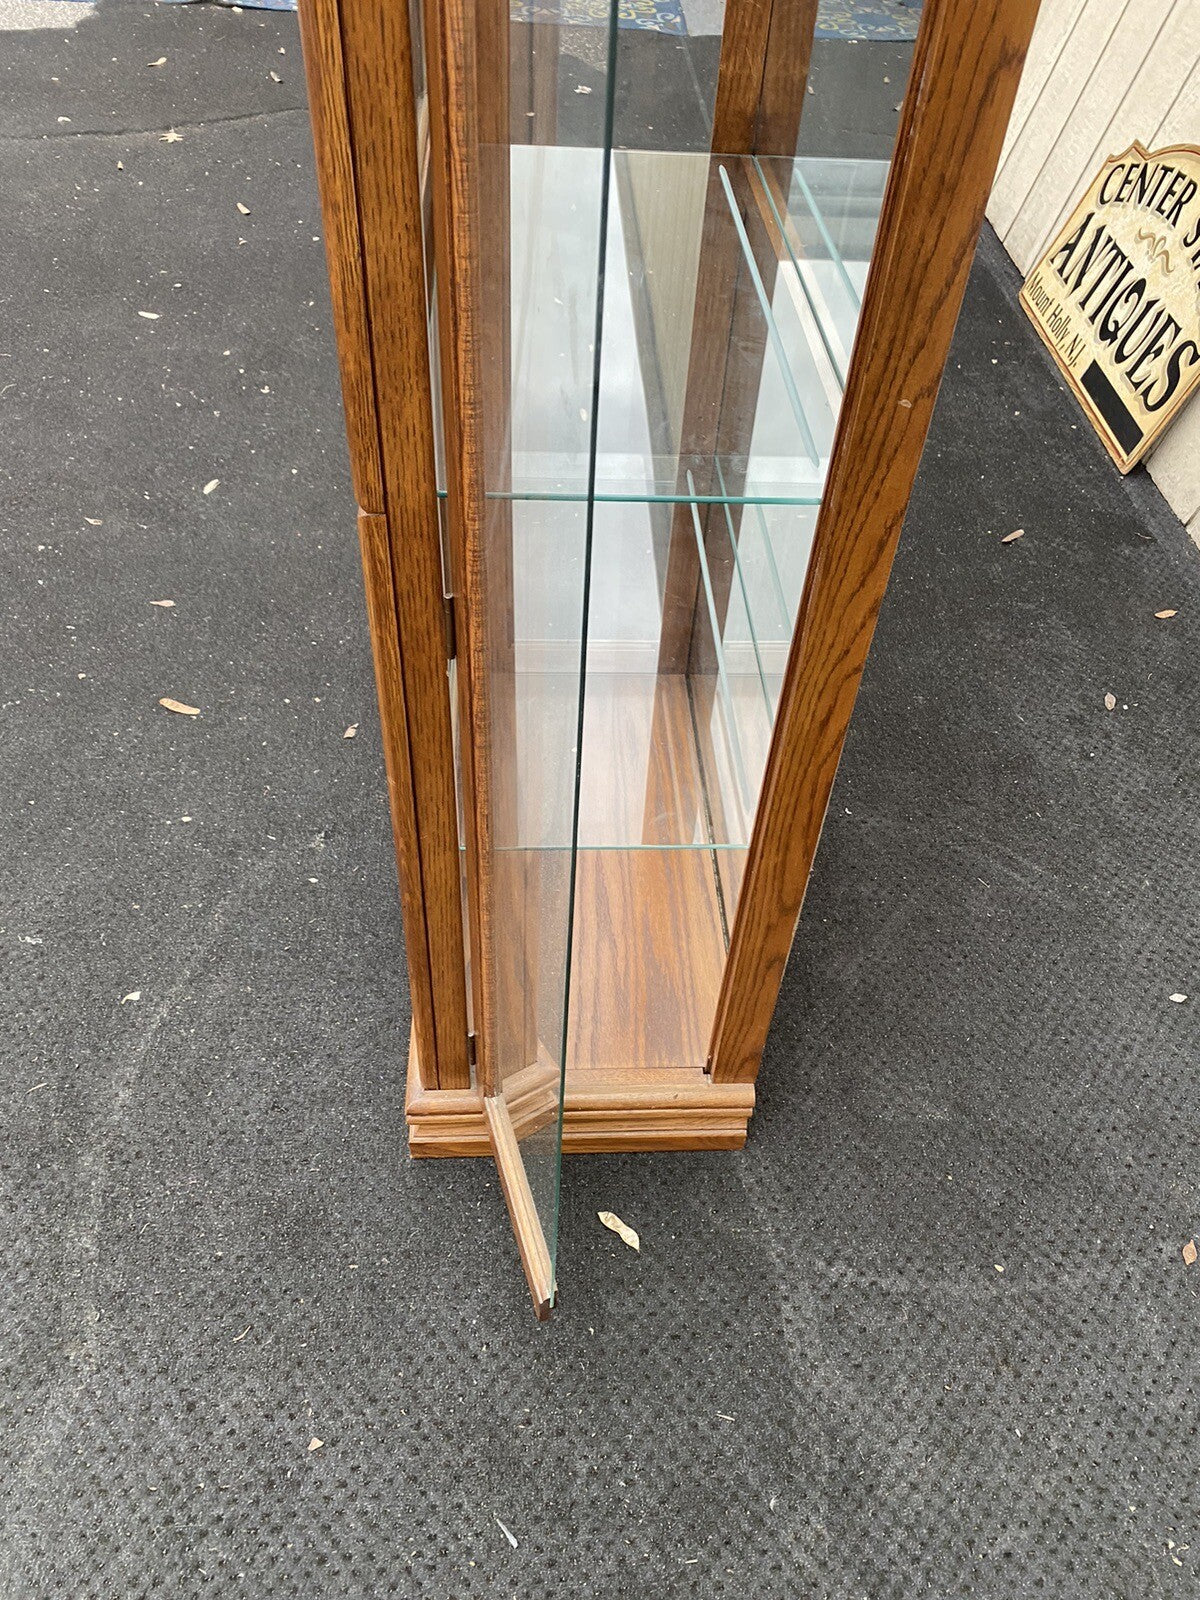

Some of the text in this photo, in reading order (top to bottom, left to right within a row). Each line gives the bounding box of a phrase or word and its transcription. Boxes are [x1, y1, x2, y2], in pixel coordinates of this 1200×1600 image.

[1098, 162, 1198, 229] CENTER
[1026, 271, 1087, 368] Mount Holly, N.J.
[1049, 211, 1200, 413] ANTIQUES
